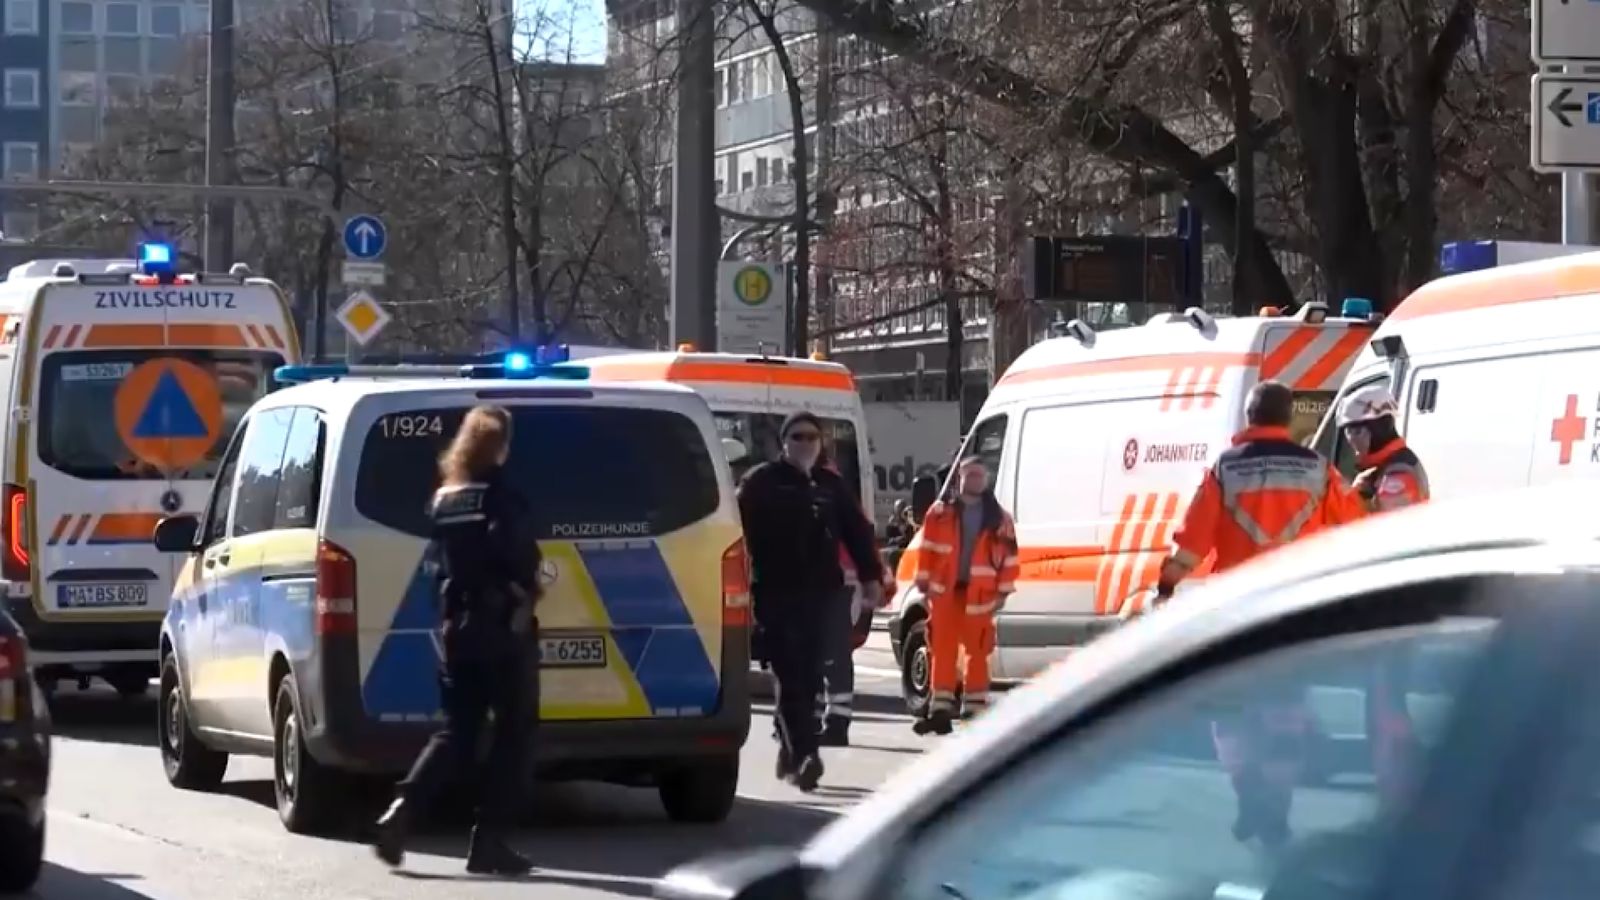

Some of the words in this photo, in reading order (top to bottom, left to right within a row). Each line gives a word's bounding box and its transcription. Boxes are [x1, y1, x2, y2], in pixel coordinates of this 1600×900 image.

[95, 291, 237, 309] ZIVILSCHUTZ
[380, 415, 443, 437] 1/924
[1144, 443, 1208, 462] JOHANNITER
[552, 522, 649, 535] POLIZEIHUNDE
[558, 640, 602, 660] 6255
